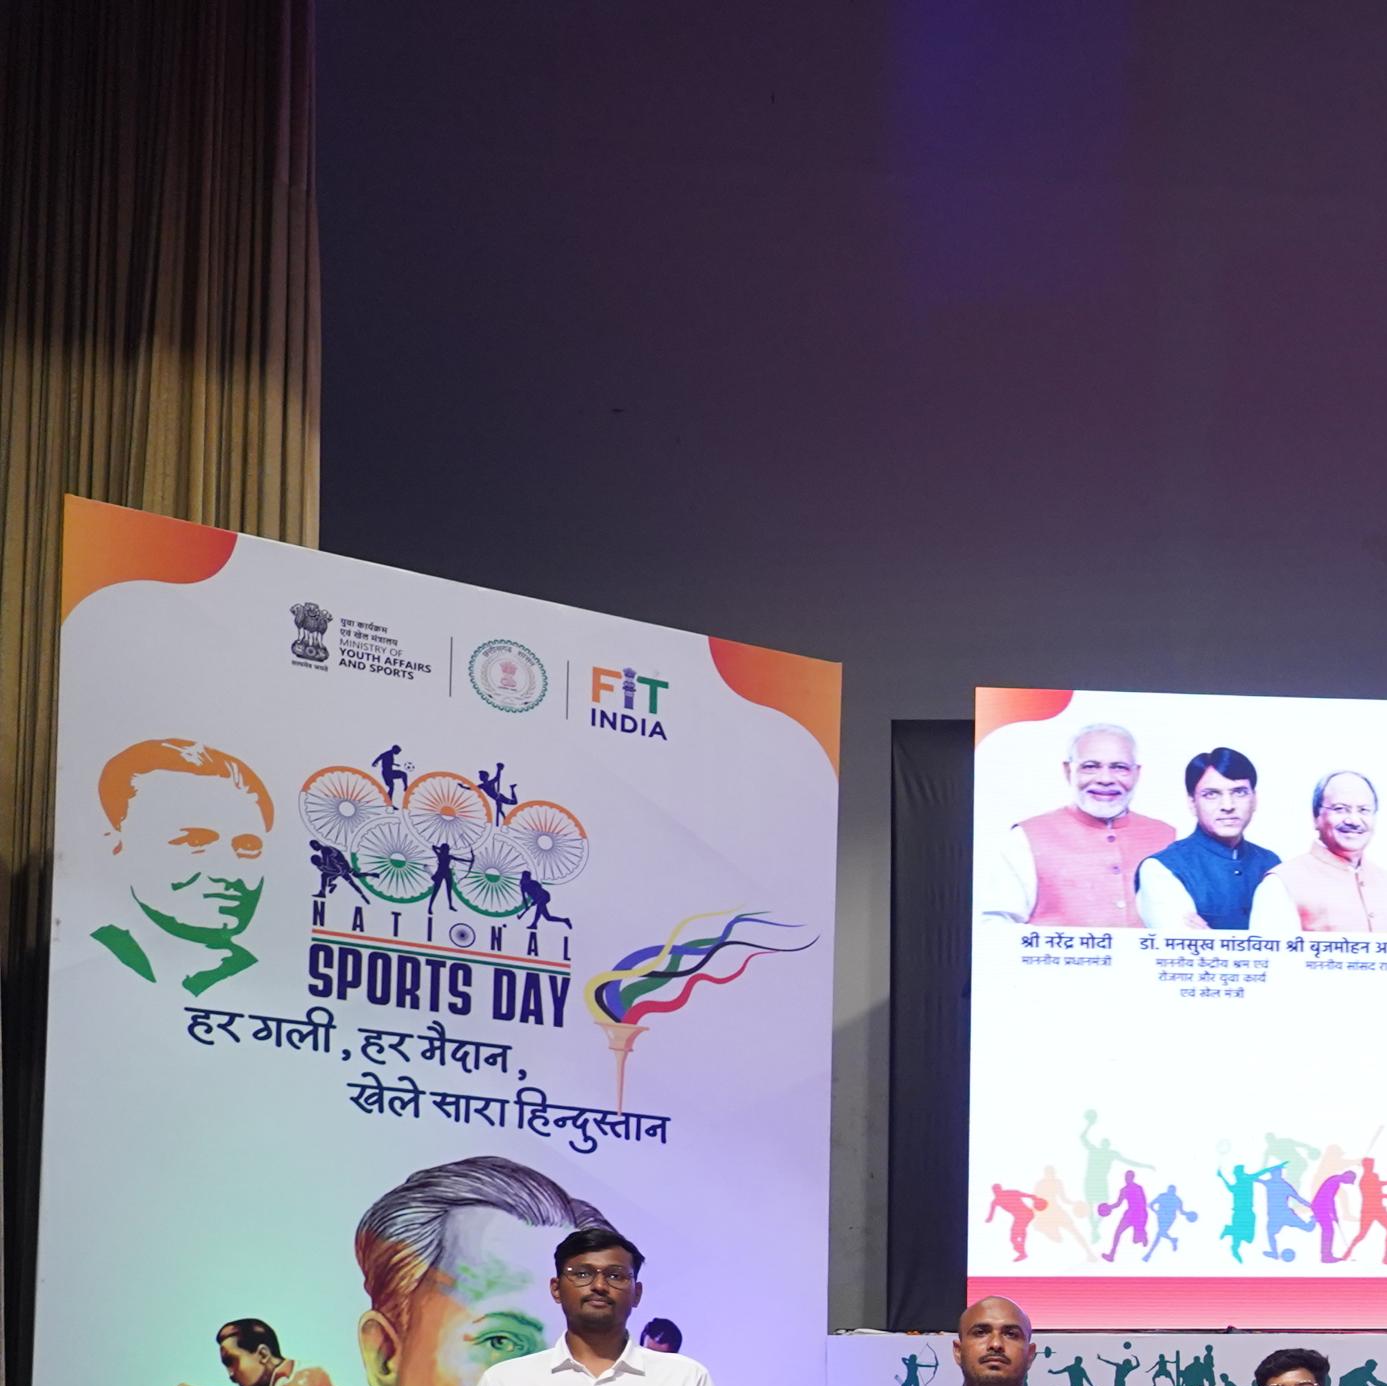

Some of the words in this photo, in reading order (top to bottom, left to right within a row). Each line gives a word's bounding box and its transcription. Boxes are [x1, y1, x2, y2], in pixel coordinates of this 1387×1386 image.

[340, 638, 387, 654] MINISTRY
[389, 648, 403, 657] OF
[339, 647, 380, 663] YOUTH
[384, 657, 432, 673] AFFAIRS
[339, 658, 366, 670] AND
[369, 664, 414, 680] SPORTS
[590, 708, 668, 740] INDIA
[1021, 932, 1040, 948] श्री
[1080, 933, 1112, 949] मोदी
[1165, 938, 1215, 956] मनसुख
[1220, 935, 1280, 952] मांडविया
[1286, 936, 1304, 952] श्री
[308, 943, 473, 1016] SPORTS
[492, 967, 571, 1028] DAY
[184, 1007, 244, 1045] हर
[357, 1028, 414, 1065] हर
[347, 1071, 426, 1119] खेले
[430, 1092, 510, 1128] सारा
[514, 1087, 671, 1154] हिन्दुस्तान
